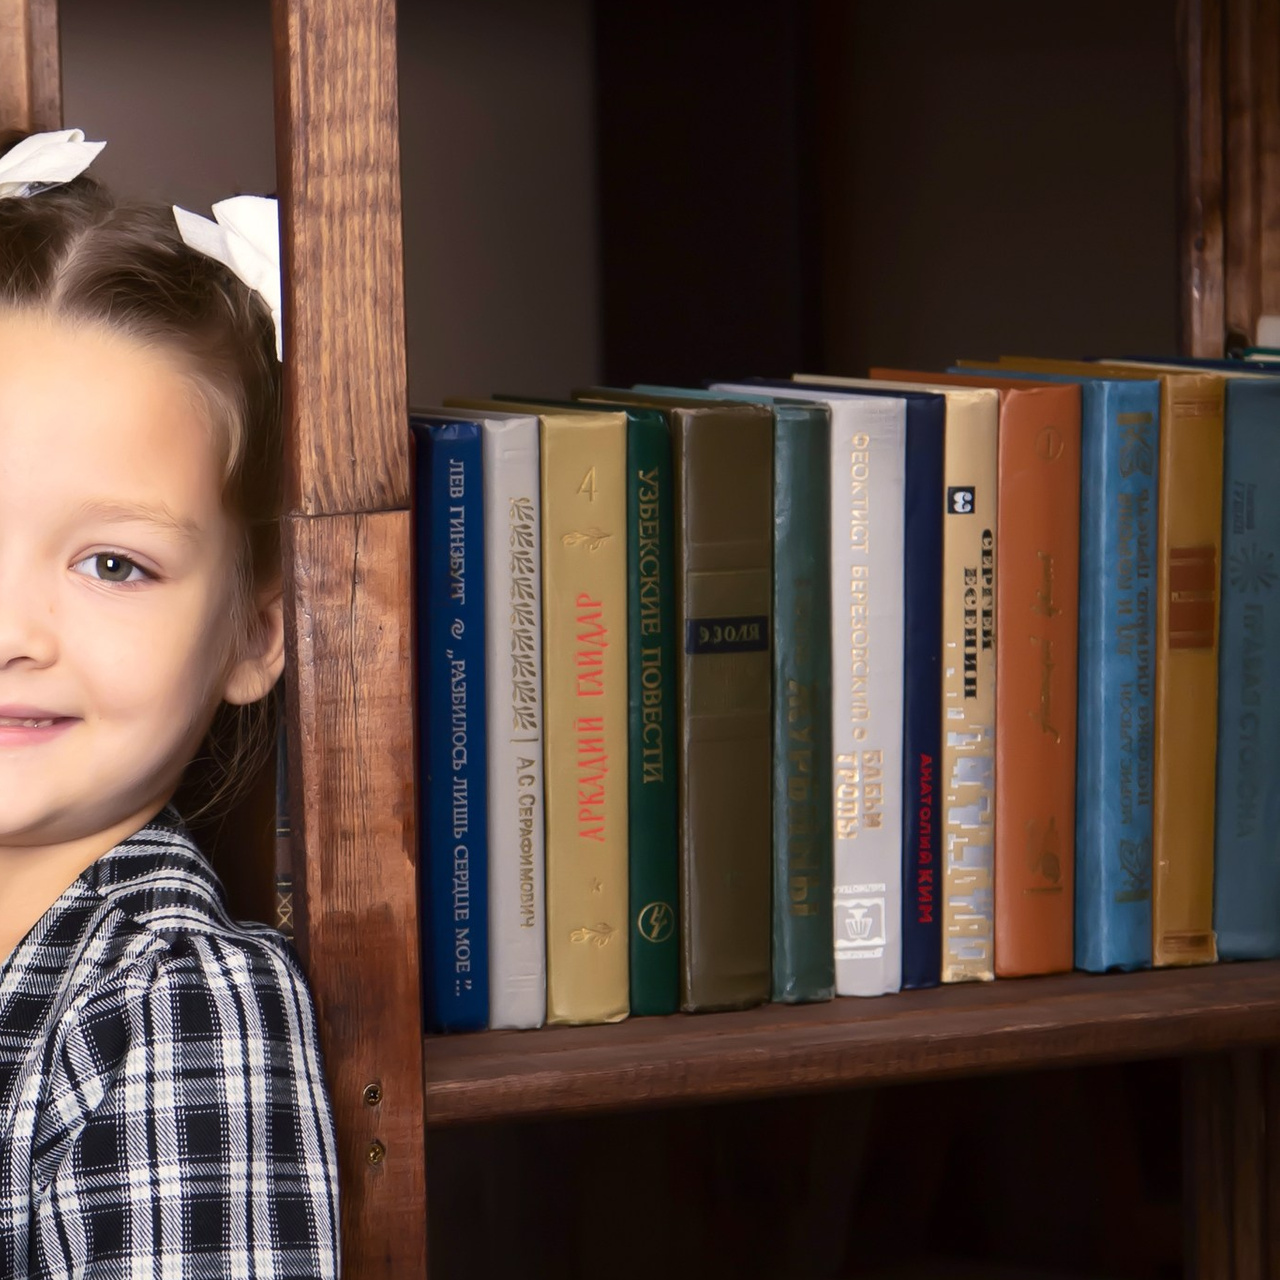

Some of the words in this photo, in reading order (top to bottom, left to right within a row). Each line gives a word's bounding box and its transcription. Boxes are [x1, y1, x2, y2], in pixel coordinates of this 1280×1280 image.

[449, 458, 465, 498] ЛЕВ
[576, 465, 599, 503] 4
[850, 431, 870, 554] ФЕОКТИСТ
[449, 505, 466, 605] ГИНЗБУРГ
[637, 466, 662, 636] УЗБЕКСКИЕ
[982, 529, 995, 651] СЕРГЕЙ
[573, 592, 609, 697] ГАЙДАР
[849, 565, 871, 722] БЕРЕЗОВСКИЙ
[964, 567, 978, 699] ЕСЕНИН
[640, 646, 664, 784] ПОВЕСТИ
[1120, 682, 1132, 753] ДРЮОН
[453, 775, 468, 839] ЛИШЬ
[573, 716, 608, 843] АРКАДИЙ
[837, 751, 859, 839] ТРОПЫ
[862, 750, 884, 829] БАБЬИ
[918, 754, 934, 864] АНАТОЛИЙ
[1121, 759, 1132, 824] МОРИС
[453, 844, 469, 922] СЕРДЦЕ
[917, 869, 934, 923] КИМ
